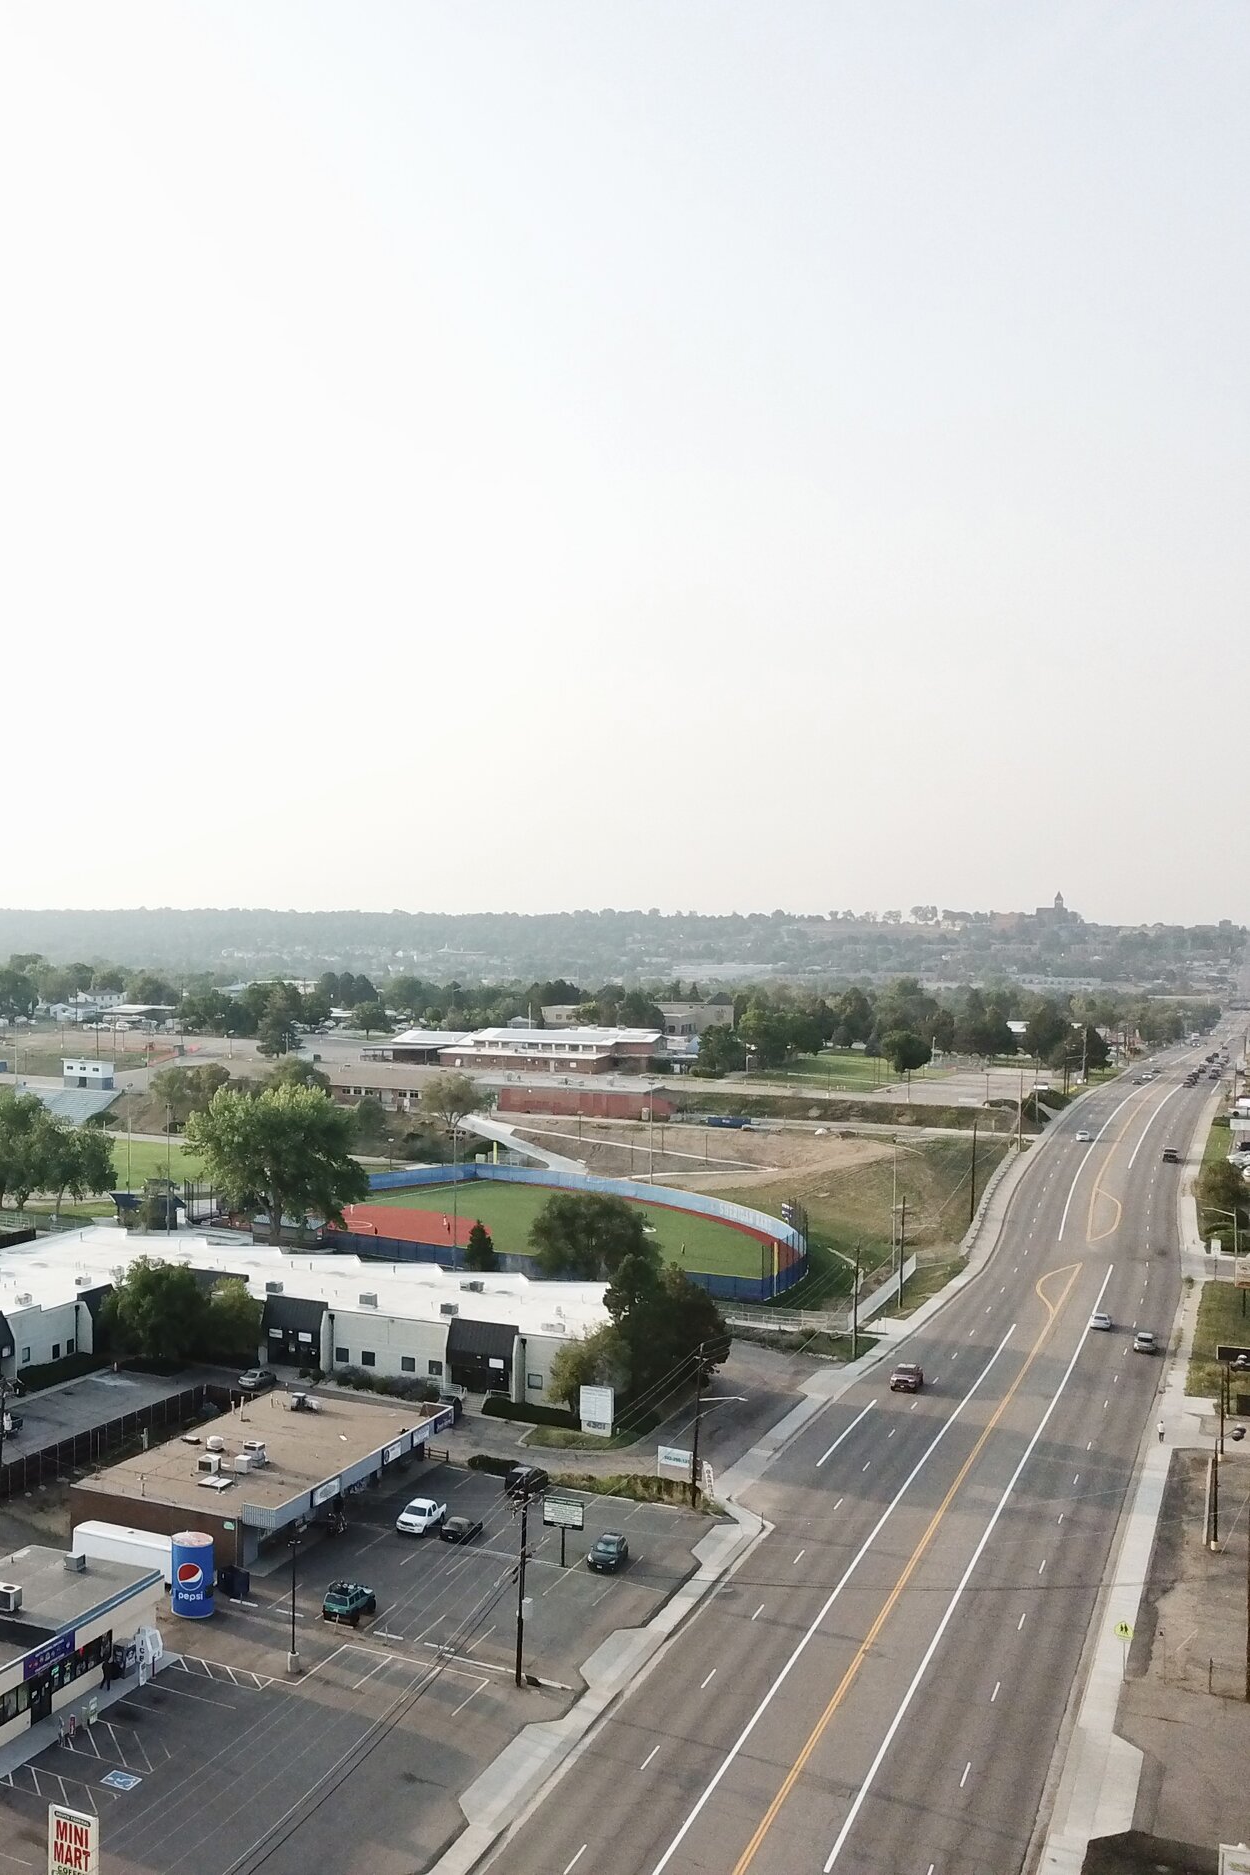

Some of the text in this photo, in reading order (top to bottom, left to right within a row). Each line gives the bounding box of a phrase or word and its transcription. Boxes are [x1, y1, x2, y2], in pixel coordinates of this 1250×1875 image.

[719, 1202, 755, 1225] SHERIDAN
[178, 1592, 203, 1602] pepsi
[56, 1820, 89, 1849] MINI
[54, 1841, 91, 1872] MART
[57, 1865, 86, 1875] COFF
